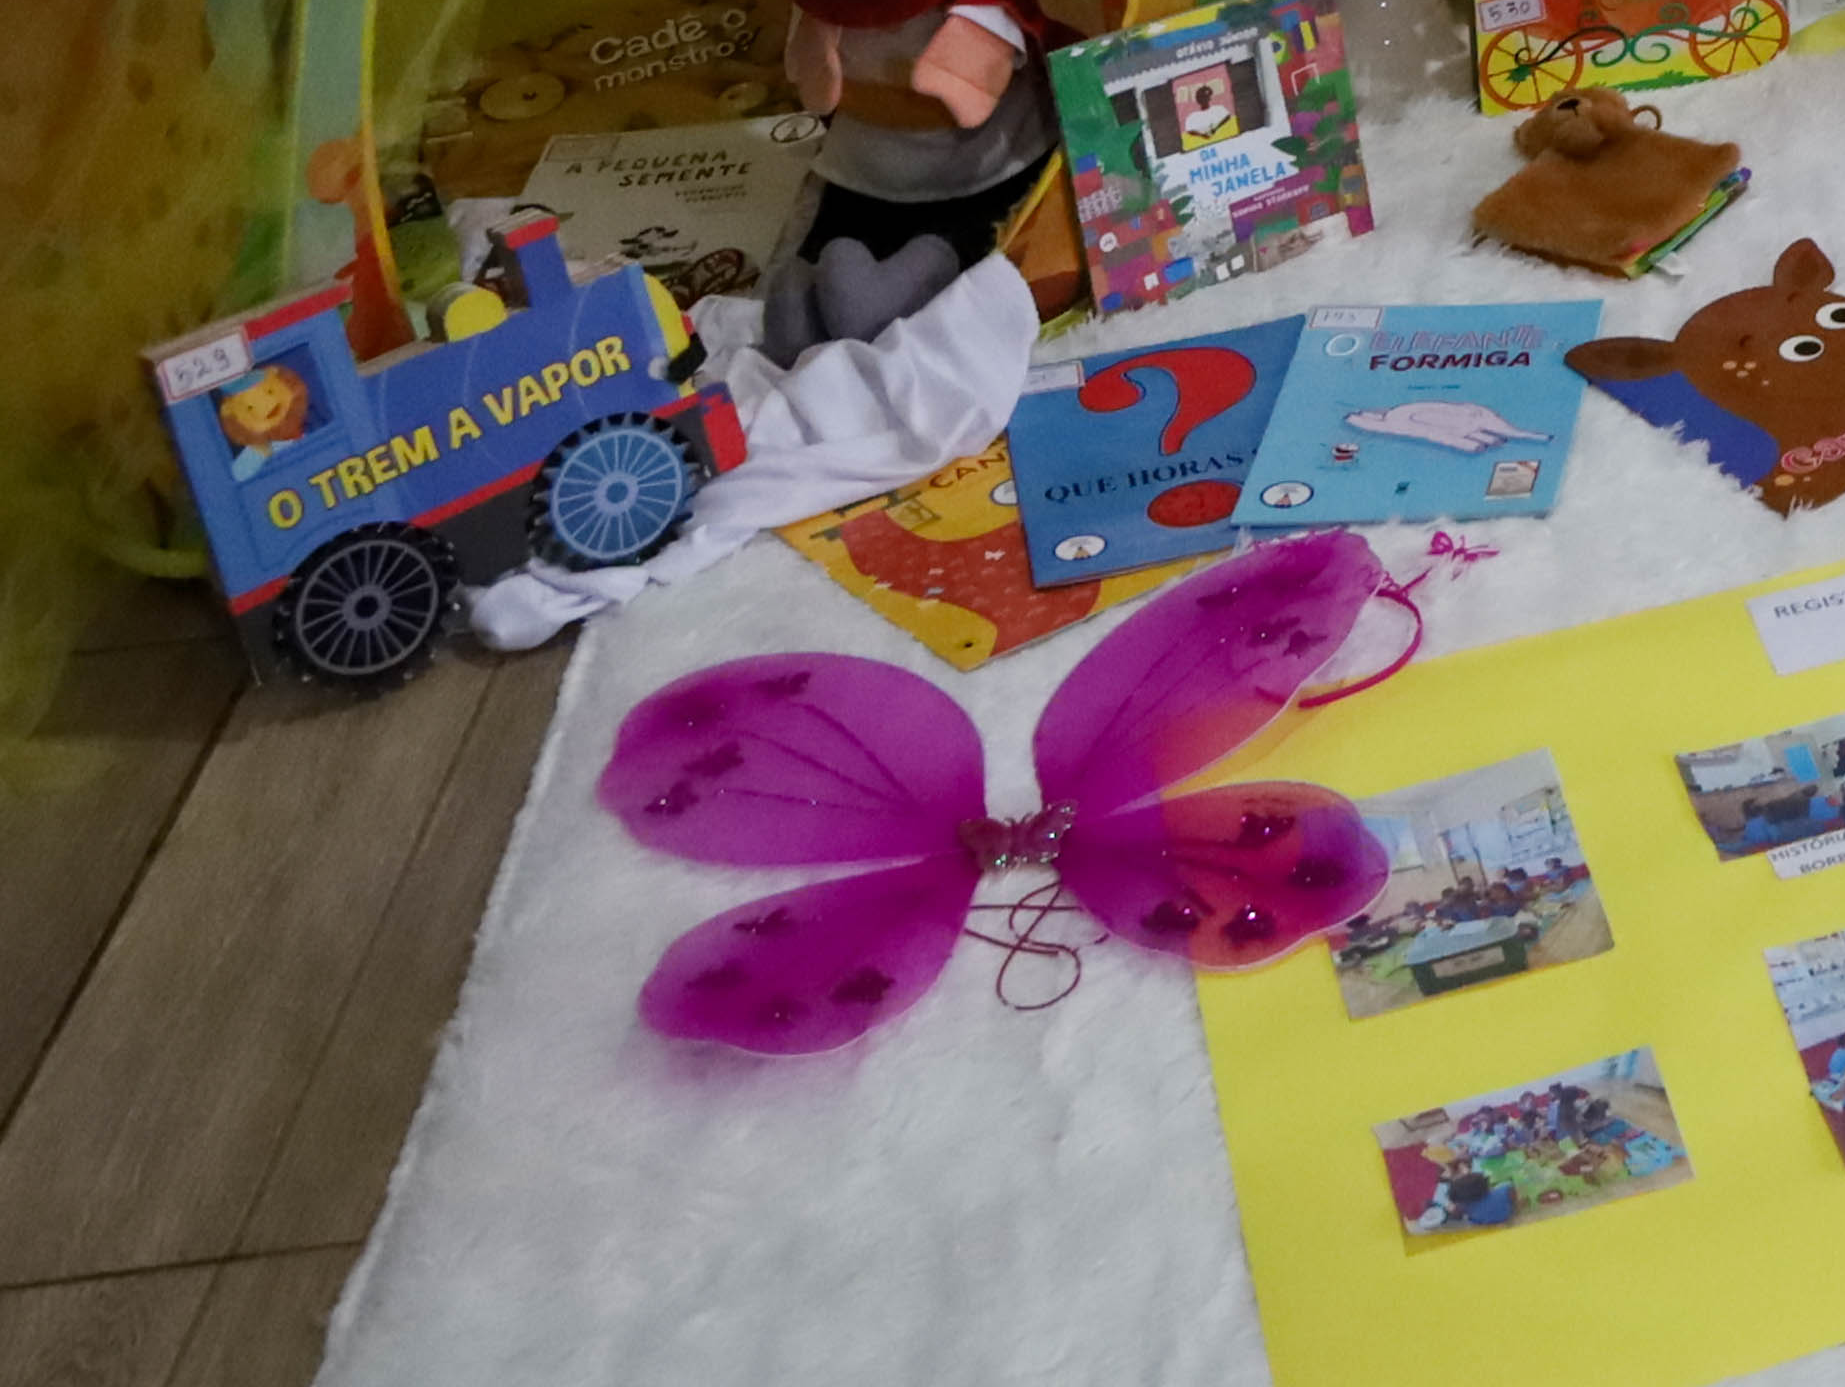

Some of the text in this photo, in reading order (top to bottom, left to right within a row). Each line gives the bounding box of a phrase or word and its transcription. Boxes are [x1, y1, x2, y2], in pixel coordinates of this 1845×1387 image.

[590, 8, 747, 64] Cadê o
[593, 29, 753, 91] monstro?
[1189, 153, 1251, 184] MINHA
[1200, 147, 1218, 162] DA
[618, 162, 752, 188] SEMENTE
[1212, 161, 1287, 198] JANELA
[1326, 324, 1545, 358] O ELEFANTE
[1368, 349, 1532, 373] FORMIGA
[268, 335, 631, 528] O TREM A VAPOR
[1044, 451, 1245, 504] QUE HORAS
